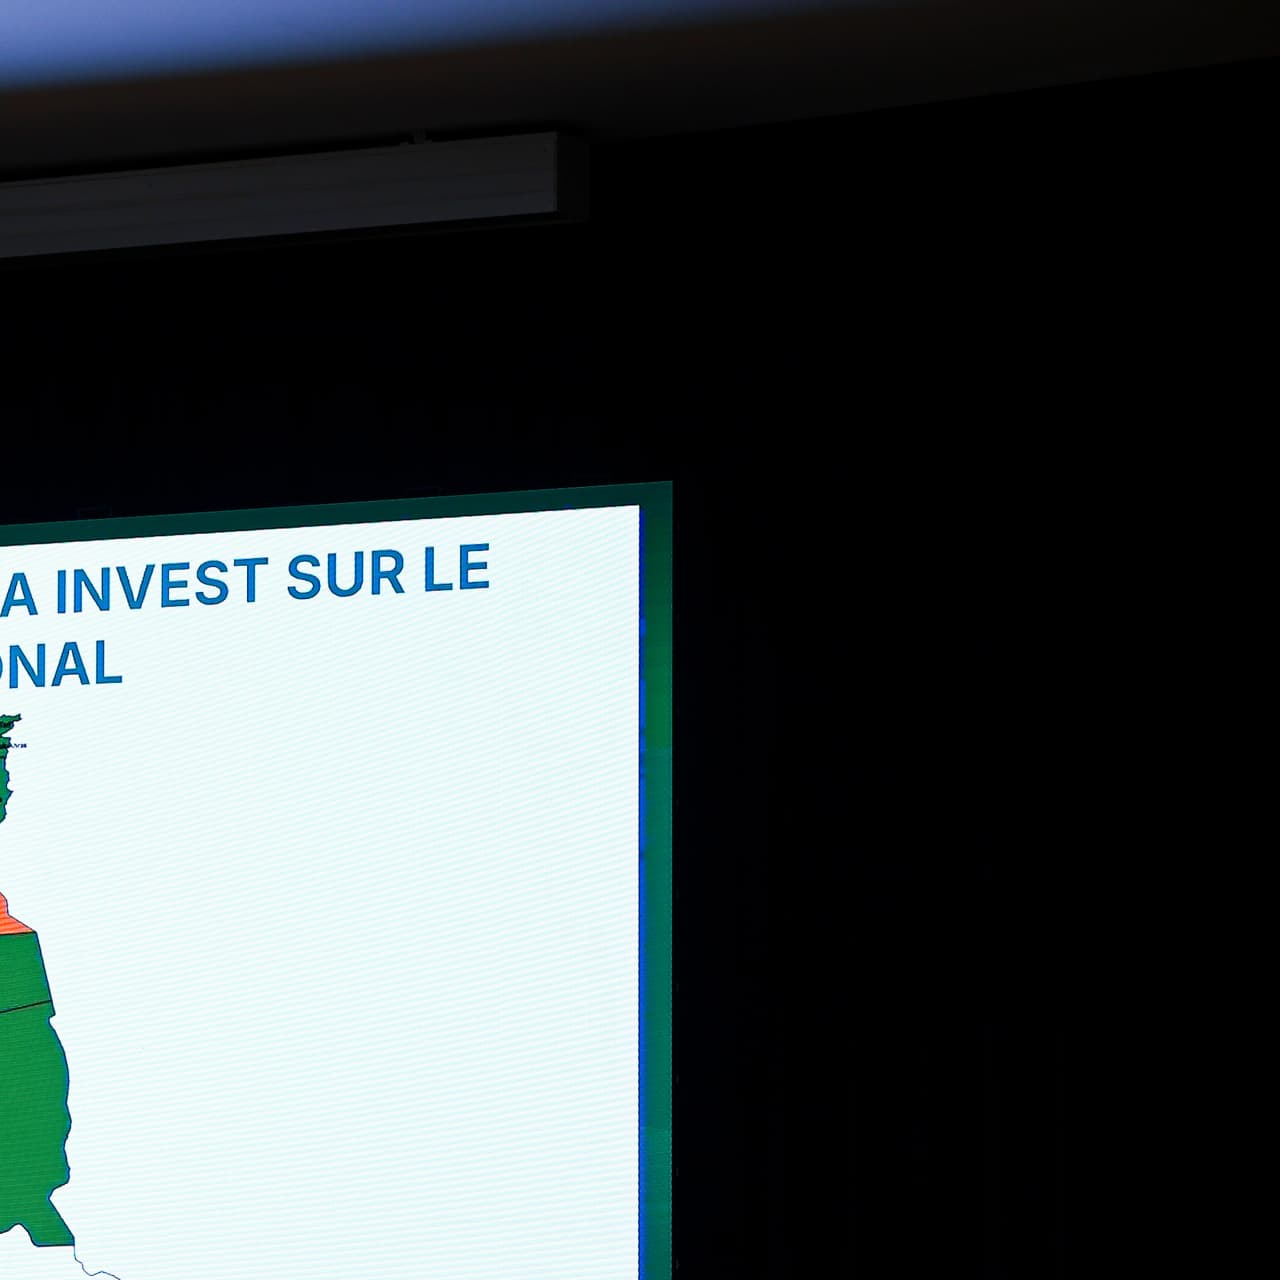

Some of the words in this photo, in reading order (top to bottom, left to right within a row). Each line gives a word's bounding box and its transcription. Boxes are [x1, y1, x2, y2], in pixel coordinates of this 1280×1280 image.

[56, 556, 269, 615] INVEST
[287, 548, 406, 600] SUR
[424, 542, 490, 593] LE
